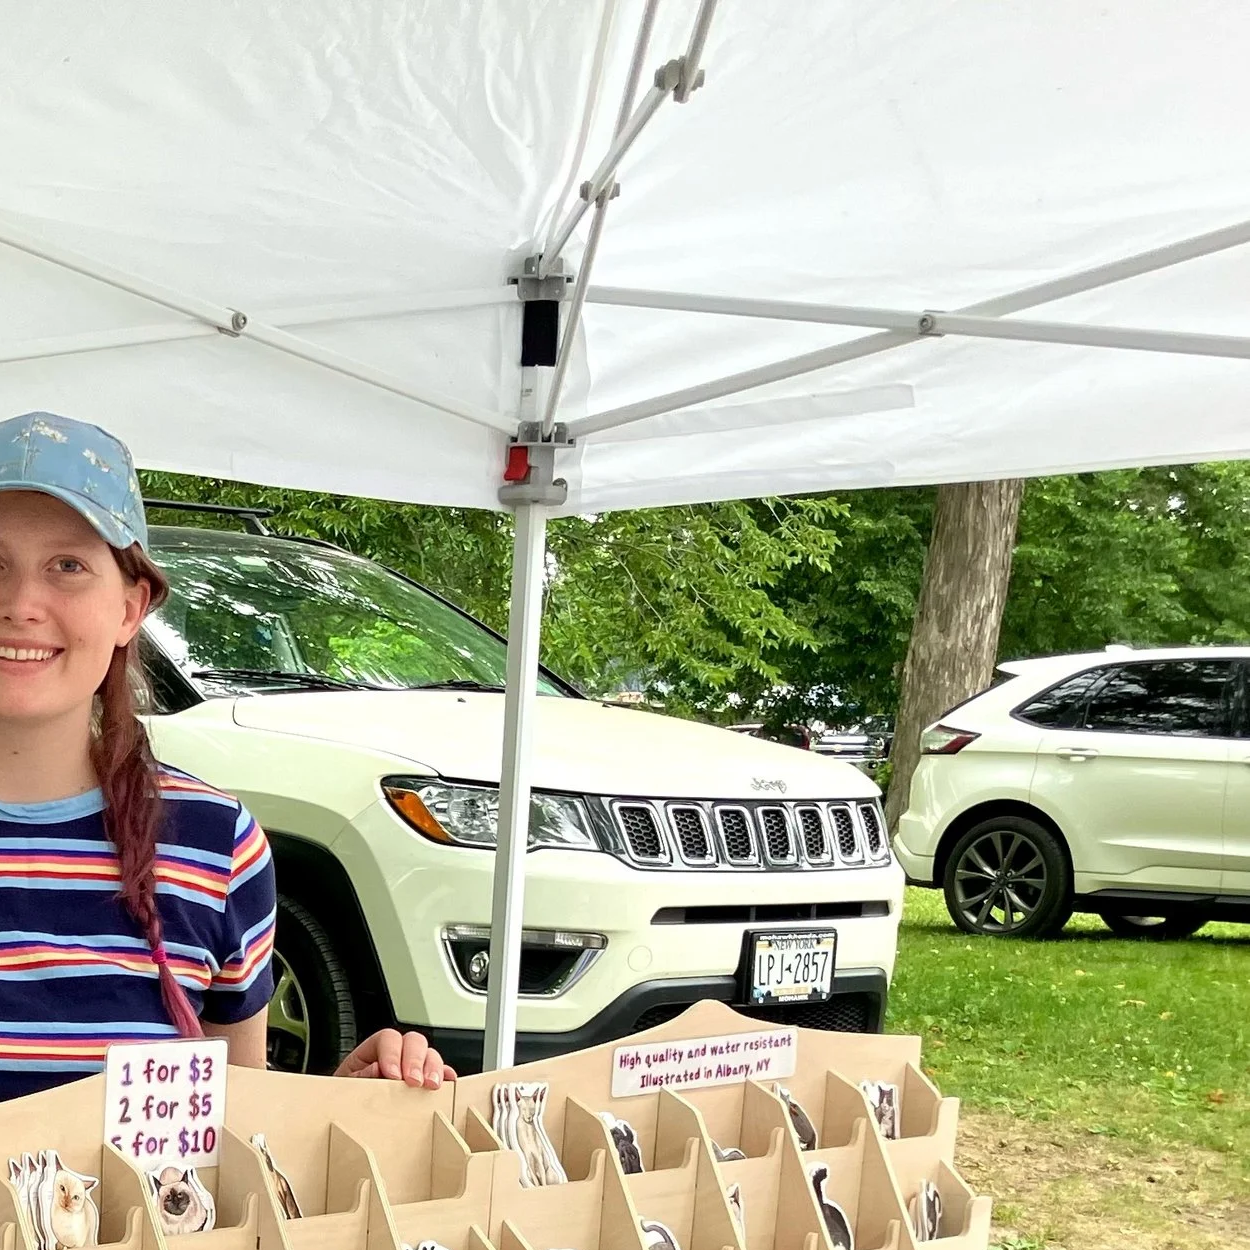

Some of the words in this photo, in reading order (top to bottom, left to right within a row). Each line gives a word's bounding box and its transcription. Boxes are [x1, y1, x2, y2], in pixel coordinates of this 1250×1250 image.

[773, 940, 792, 950] NEW
[793, 939, 815, 950] YORK
[619, 1052, 646, 1070] High
[645, 1048, 683, 1067] quality
[687, 1044, 707, 1059] and
[710, 1042, 741, 1056] water
[743, 1034, 792, 1051] resistant
[121, 1061, 133, 1086] 1
[142, 1058, 180, 1084] for
[189, 1053, 213, 1087] $3
[640, 1068, 700, 1088] Illustrated
[704, 1065, 712, 1079] in
[715, 1061, 753, 1079] Albany,
[756, 1058, 771, 1072] NY
[118, 1097, 132, 1123] 2
[142, 1095, 179, 1120] for
[189, 1090, 212, 1121] $5
[132, 1131, 169, 1157] for
[178, 1126, 216, 1157] $10
